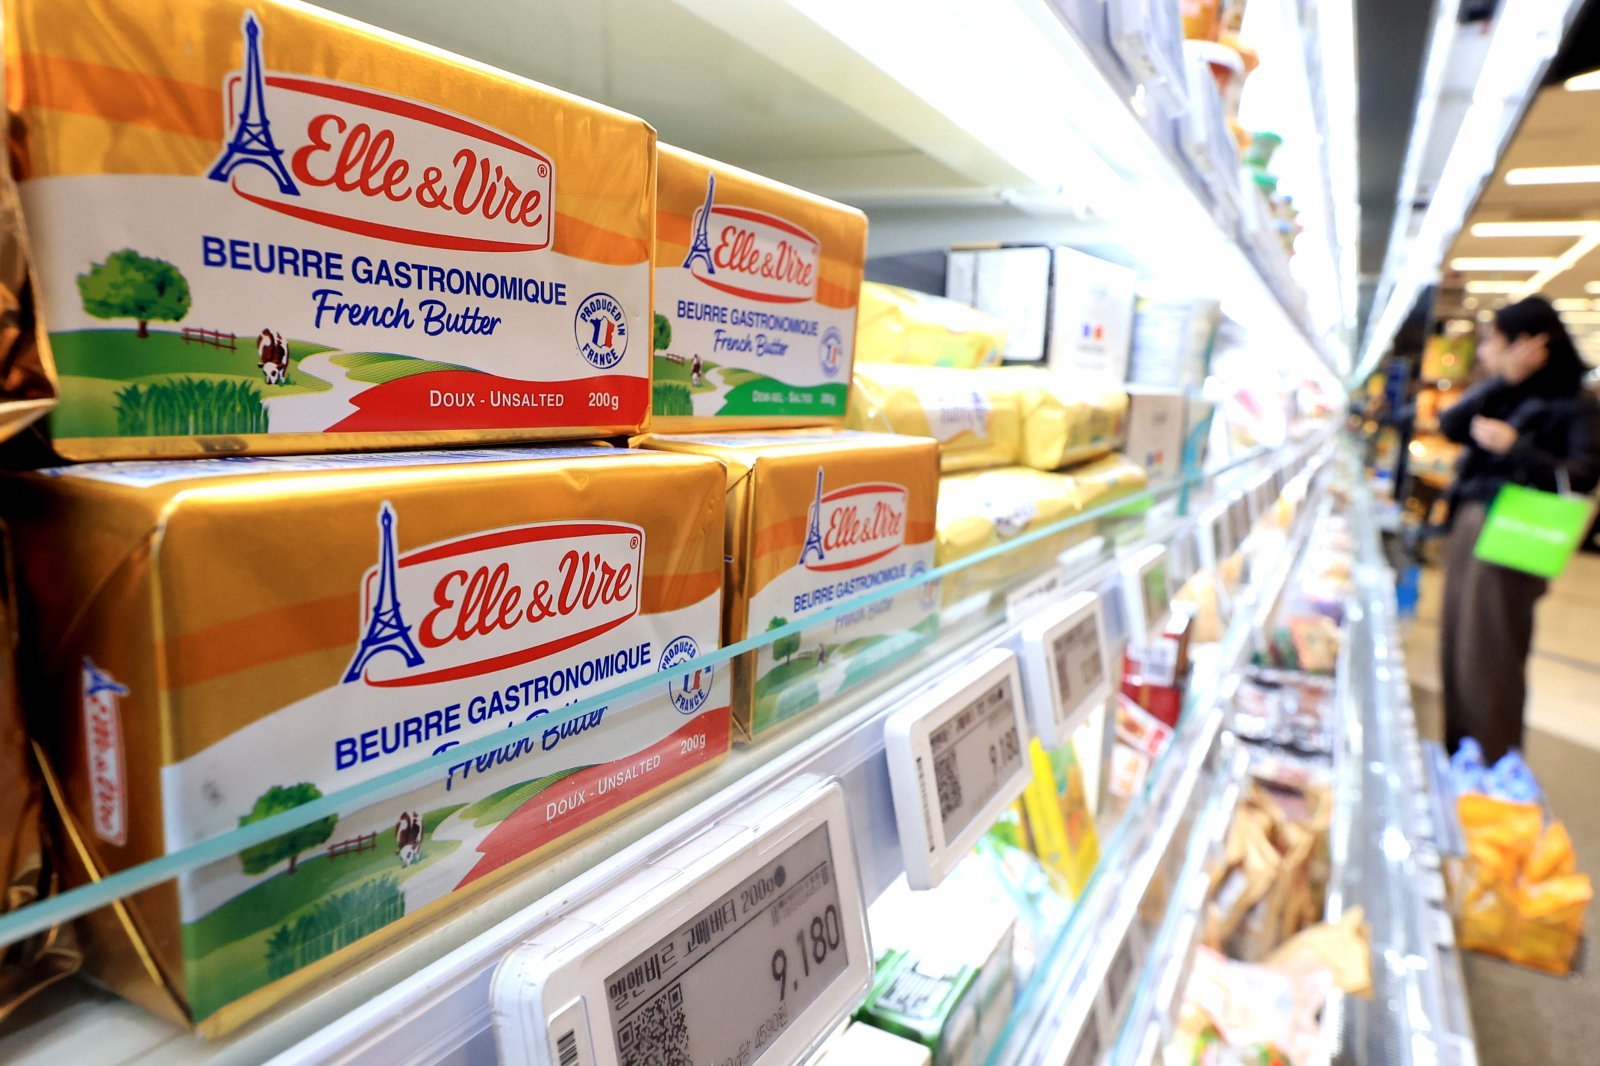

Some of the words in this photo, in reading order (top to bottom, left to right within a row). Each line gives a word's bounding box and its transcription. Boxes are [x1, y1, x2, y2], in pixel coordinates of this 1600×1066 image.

[201, 235, 344, 281] BEURRE
[351, 255, 567, 306] GASTRONOMIQUE
[312, 288, 415, 329] French
[419, 299, 502, 336] Butter
[580, 298, 622, 323] PRODUCED
[616, 323, 626, 336] IN
[676, 299, 728, 324] BEURRE
[582, 342, 619, 366] FRANCE
[713, 328, 752, 352] French
[588, 392, 619, 411] 200g
[793, 585, 834, 613] BEURRE
[661, 640, 696, 670] PRODUCED
[335, 703, 461, 771] BEURRE
[467, 642, 652, 724] GASTRONOMIQUE
[675, 688, 706, 712] FRANCE
[680, 733, 706, 756] 200g
[609, 942, 679, 1011] 엘앤비르
[682, 898, 737, 958] 고메버터
